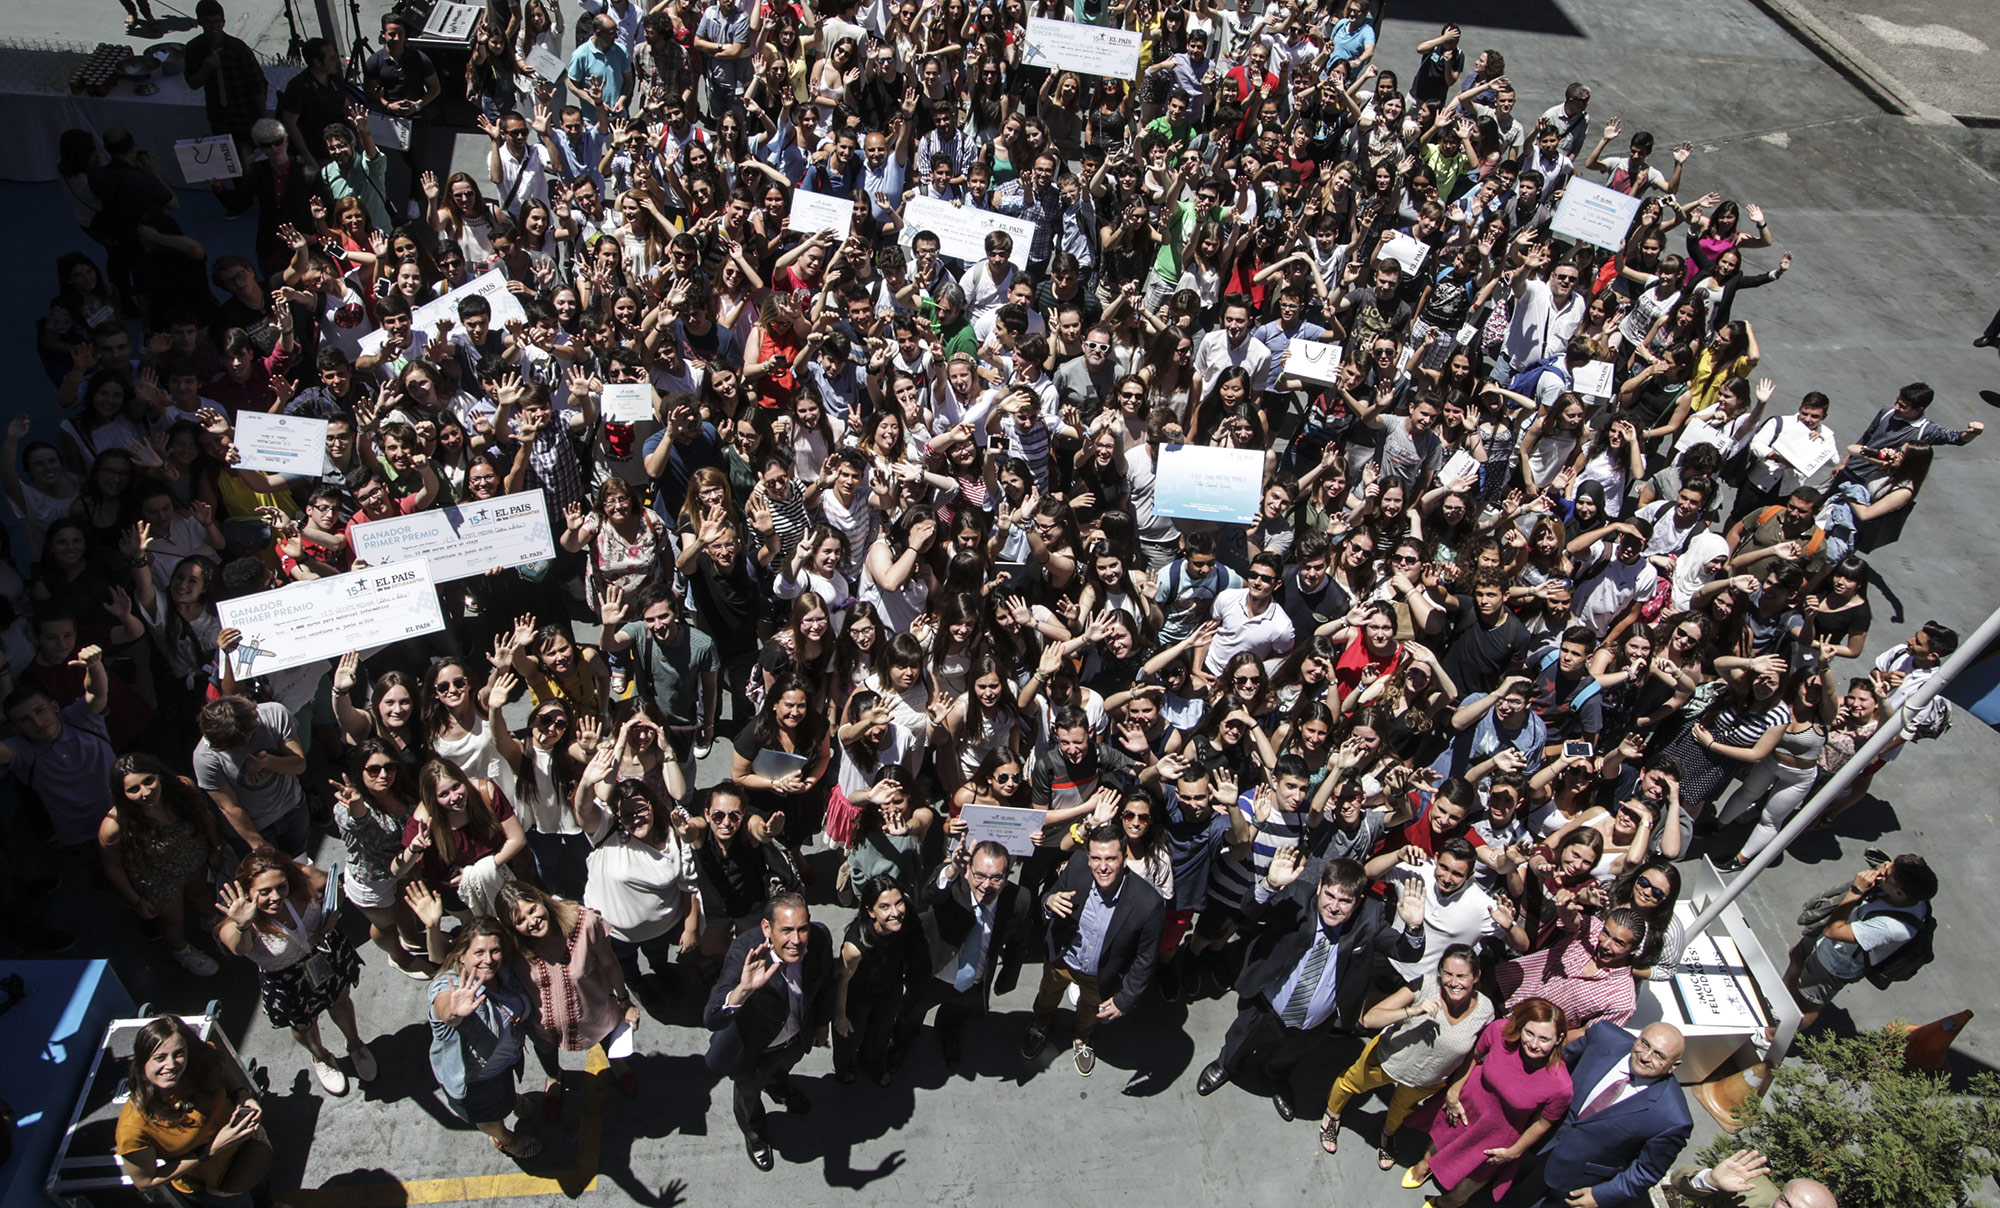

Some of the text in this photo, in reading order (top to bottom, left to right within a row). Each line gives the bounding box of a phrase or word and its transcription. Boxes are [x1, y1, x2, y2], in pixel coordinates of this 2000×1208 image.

[468, 515, 480, 526] 15
[495, 509, 509, 518] EL
[362, 526, 412, 542] GANADOR
[364, 536, 401, 550] PRIMER
[402, 528, 439, 542] PREMIO
[375, 577, 391, 588] EL
[346, 586, 359, 597] 15
[230, 599, 283, 619] GANADOR
[232, 611, 272, 627] PRIMER
[273, 601, 314, 617] PREMIO
[405, 626, 415, 634] EL
[1683, 957, 1708, 1004] ¡MUCHAS
[1688, 946, 1721, 1015] FELICIDADES!
